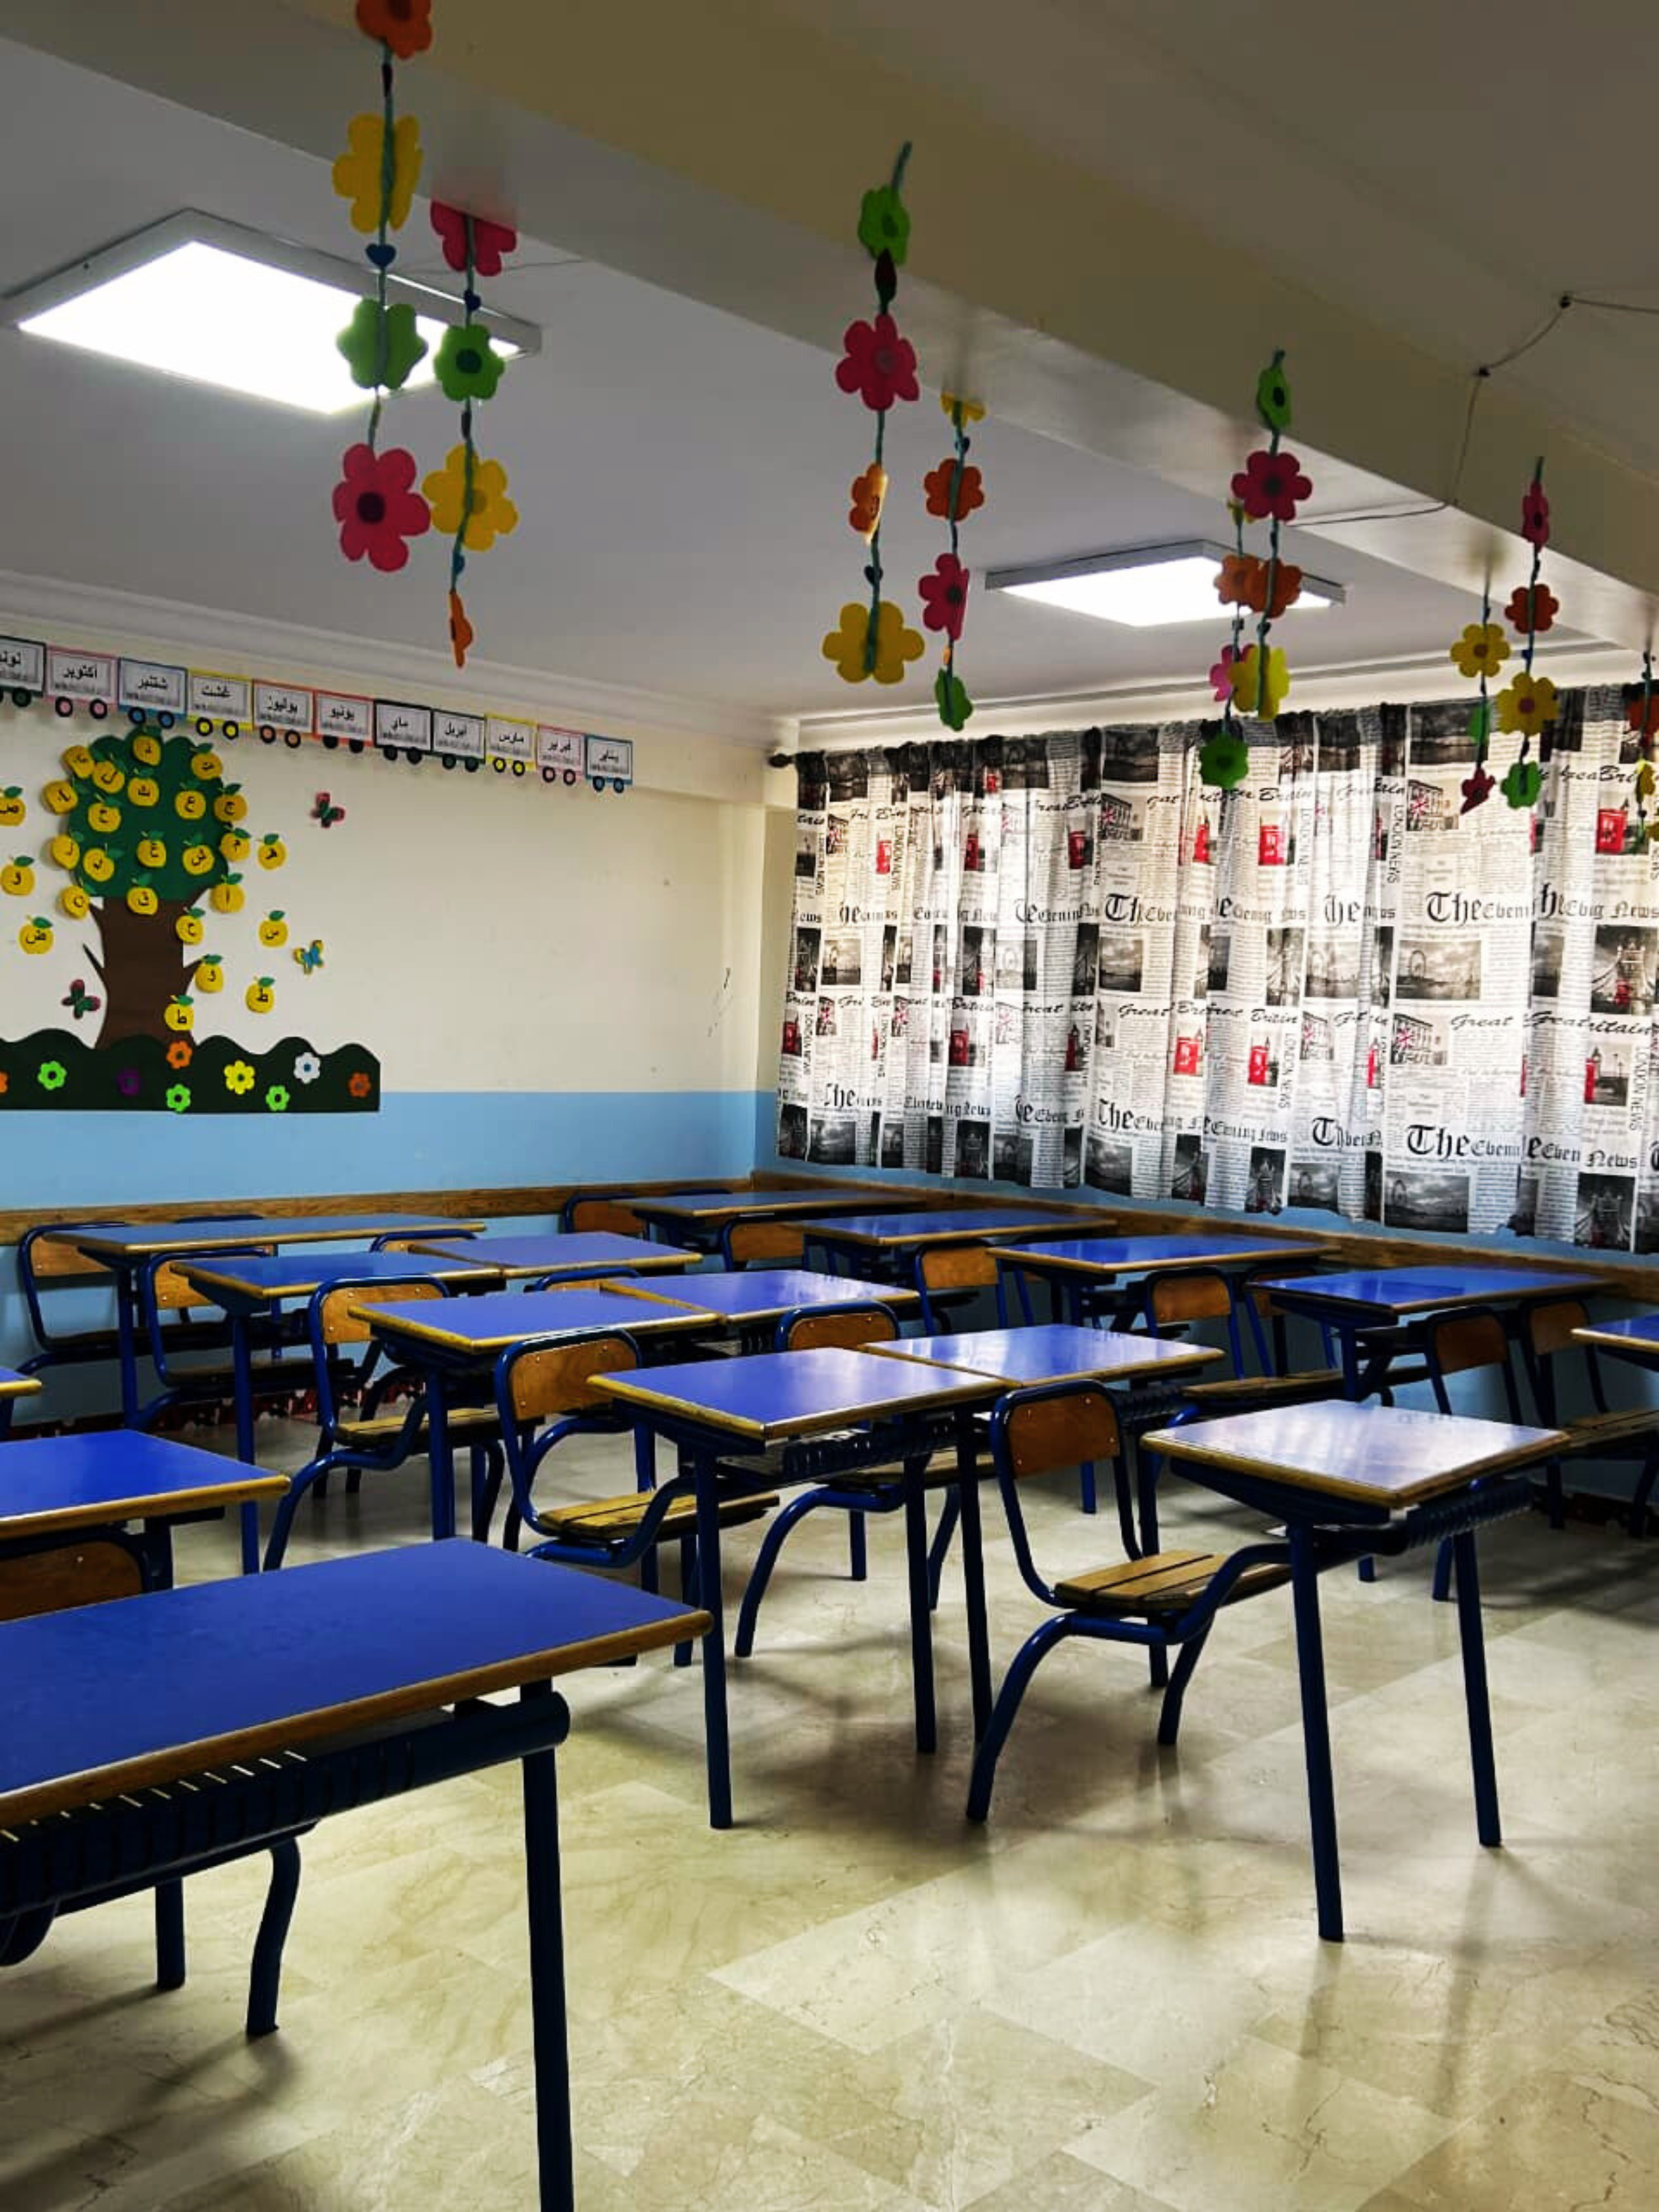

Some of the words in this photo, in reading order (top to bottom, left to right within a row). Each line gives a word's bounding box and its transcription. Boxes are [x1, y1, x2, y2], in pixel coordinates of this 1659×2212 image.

[1426, 890, 1481, 926] The
[1451, 1014, 1514, 1031] Great
[1589, 1020, 1653, 1036] ritain
[1282, 1032, 1296, 1076] LONDON
[1632, 1046, 1648, 1093] LONDON
[1629, 1097, 1645, 1132] NEWS
[1407, 1124, 1470, 1160] The
[1471, 1139, 1521, 1157] Evenin
[1541, 1142, 1582, 1162] Even
[1586, 1150, 1637, 1170] News
